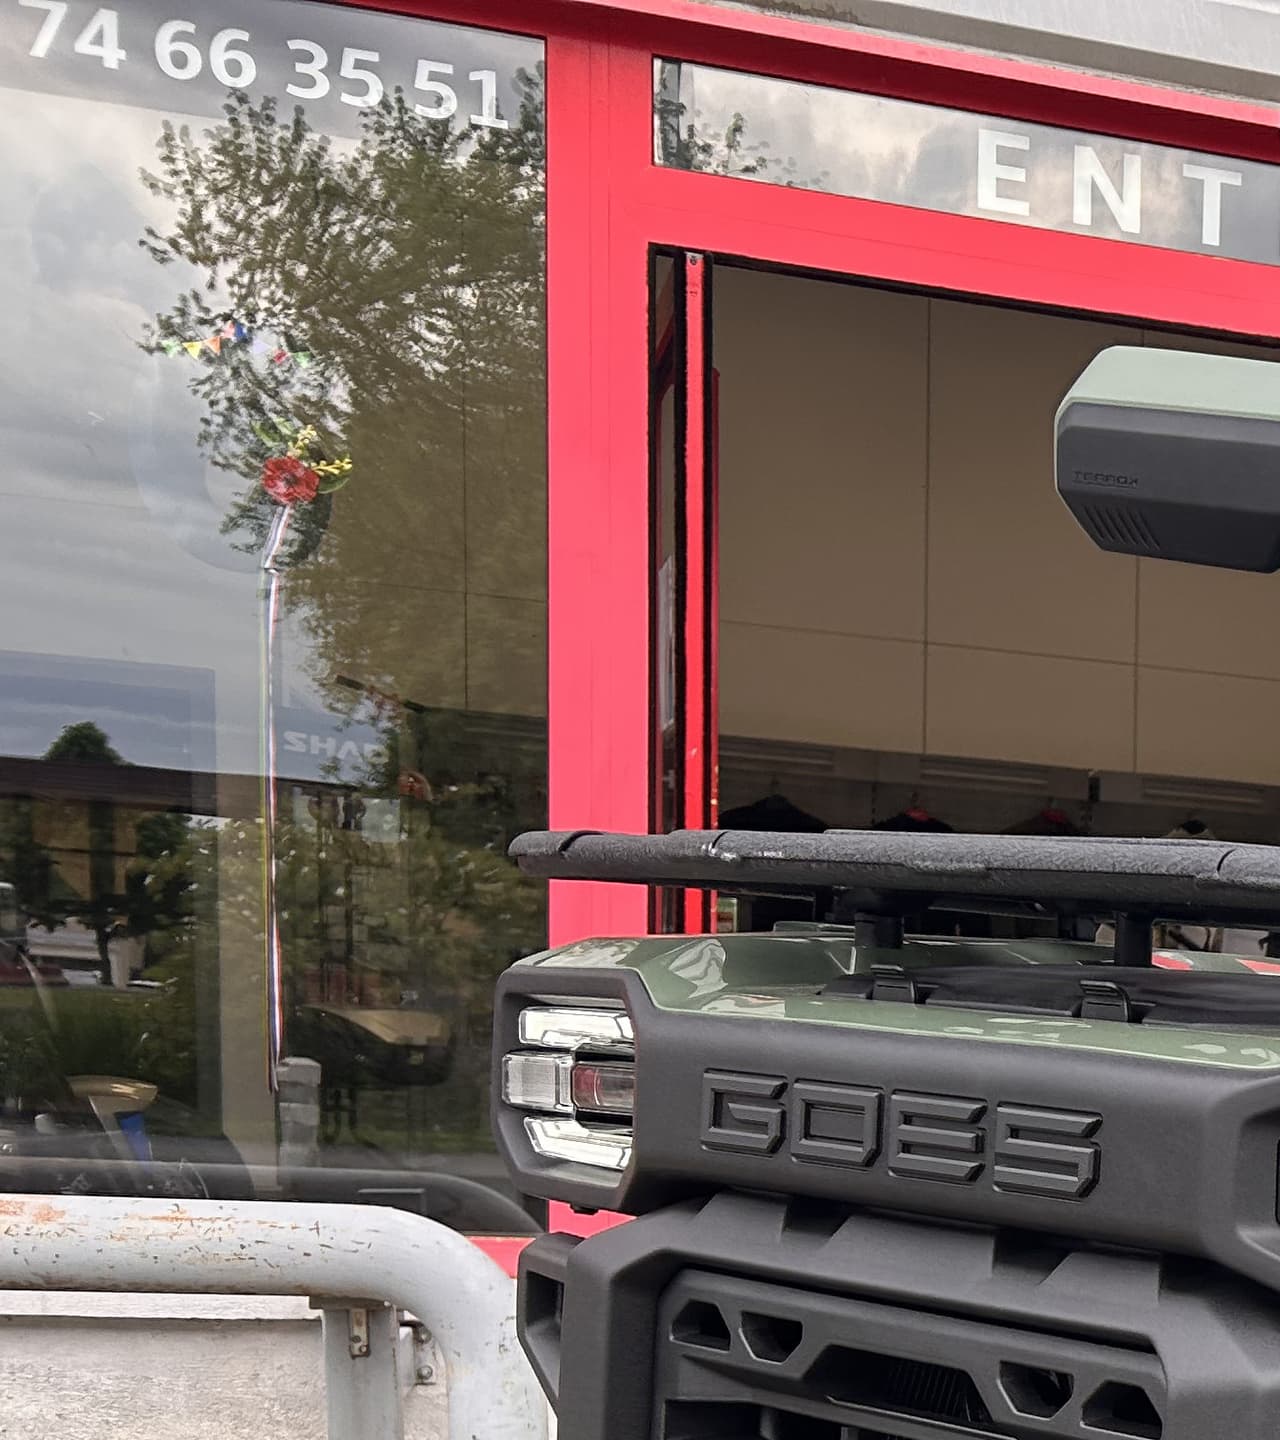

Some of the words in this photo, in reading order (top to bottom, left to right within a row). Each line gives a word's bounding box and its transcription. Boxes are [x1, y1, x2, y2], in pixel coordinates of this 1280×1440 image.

[17, 0, 127, 69] 74
[154, 20, 257, 88] 66
[285, 39, 384, 107] 35
[413, 59, 510, 129] 51
[701, 1068, 1103, 1202] GOES
